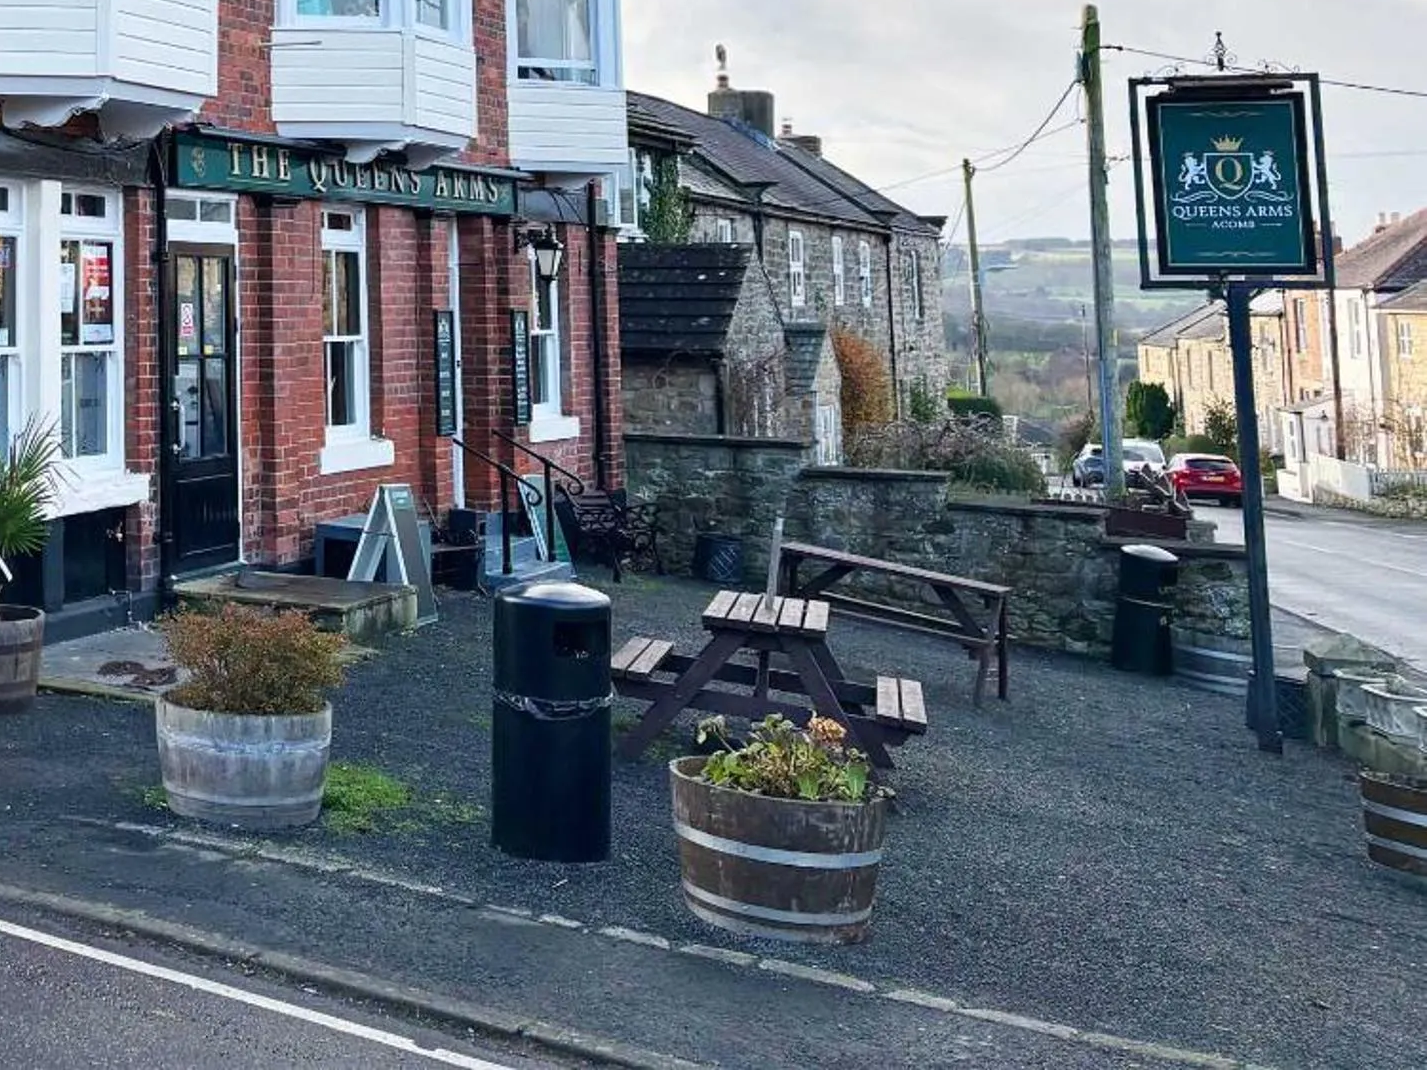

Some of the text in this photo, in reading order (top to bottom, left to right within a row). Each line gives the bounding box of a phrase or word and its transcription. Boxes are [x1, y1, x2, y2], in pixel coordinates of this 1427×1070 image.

[226, 142, 499, 203] THE QUEENS ARMS
[1173, 204, 1294, 220] QUEENS ARMS
[1211, 220, 1256, 229] ACOMB
